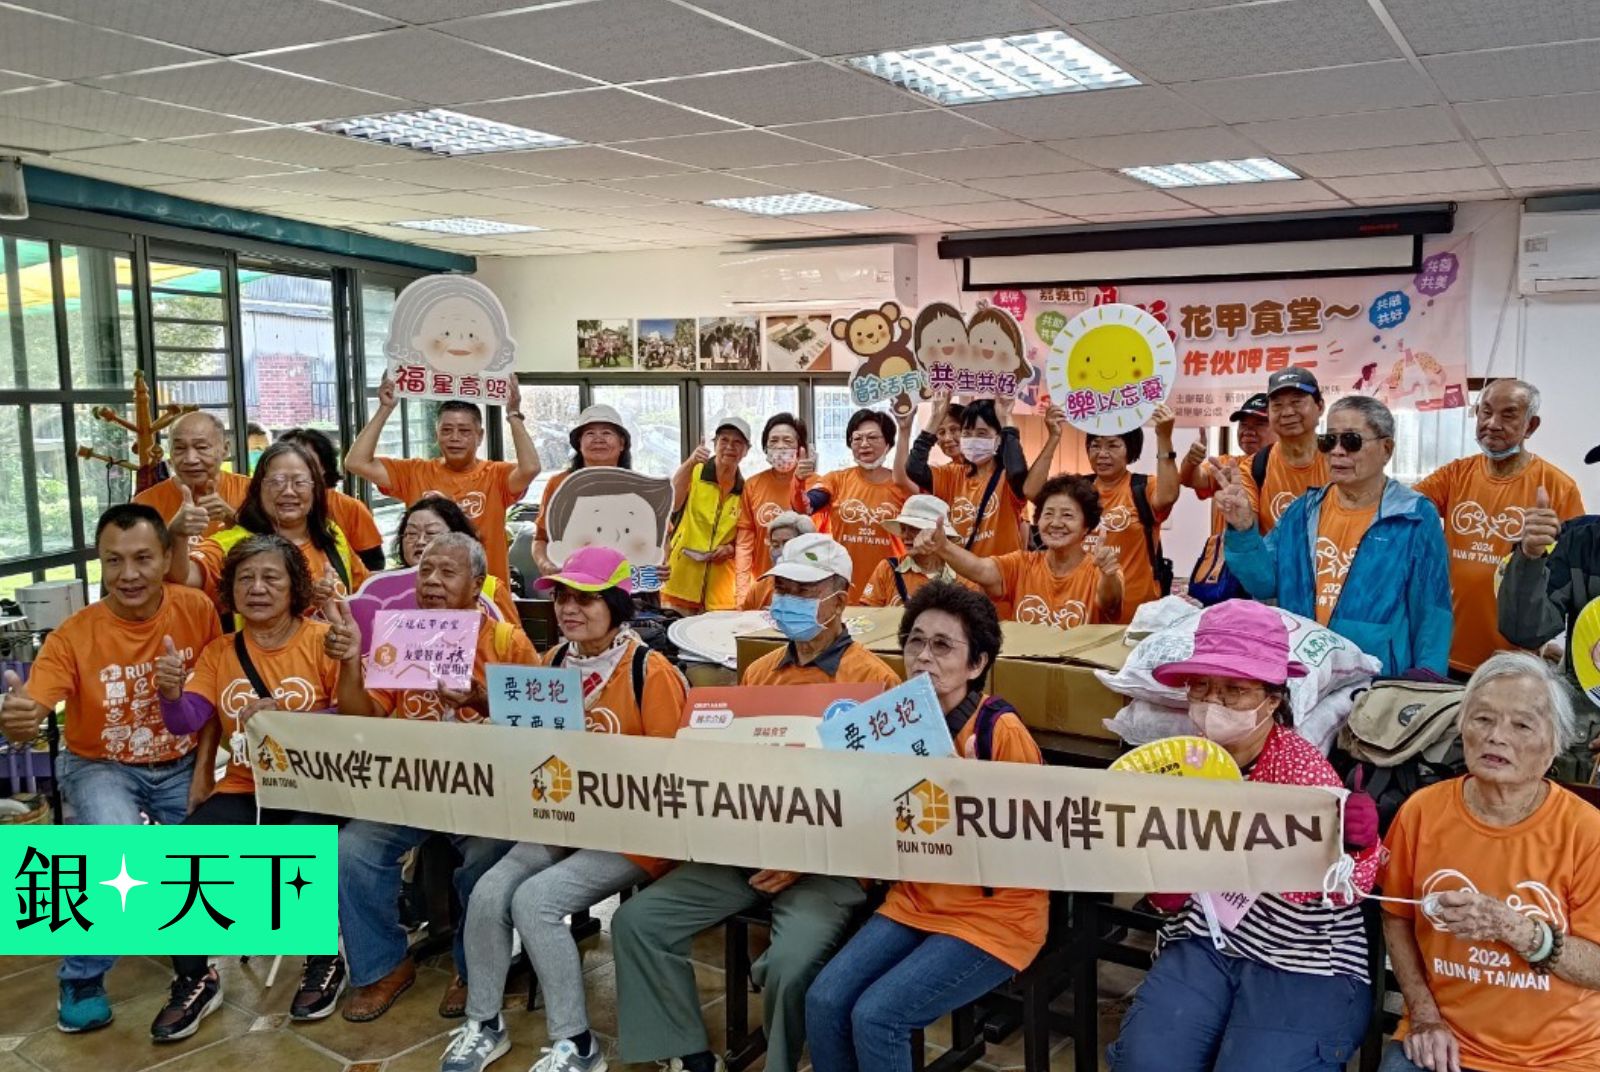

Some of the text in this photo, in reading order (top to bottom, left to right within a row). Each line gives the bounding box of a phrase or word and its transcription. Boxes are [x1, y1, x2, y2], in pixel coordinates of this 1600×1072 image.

[1376, 309, 1403, 325] 共好
[1183, 345, 1318, 376] 作伙呷百二
[396, 365, 507, 398] 福星高照
[853, 371, 925, 402] 齡活有
[931, 363, 1016, 394] 共生共好
[1067, 378, 1162, 419] 樂以忘憂
[1471, 541, 1494, 553] 2024
[1322, 583, 1341, 594] 202
[504, 676, 568, 704] 要抱抱
[844, 697, 923, 752] 要抱抱
[286, 748, 494, 797] RUN伴TAIWAN
[577, 770, 843, 828] RUN伴TAIWAN
[533, 808, 575, 822] RUN TOMO
[956, 795, 1323, 852] RUN伴TAIWAN
[897, 840, 952, 856] RUN TOMO
[1468, 946, 1511, 967] 2024
[1434, 958, 1550, 991] RUN 伴 TAIWAN
